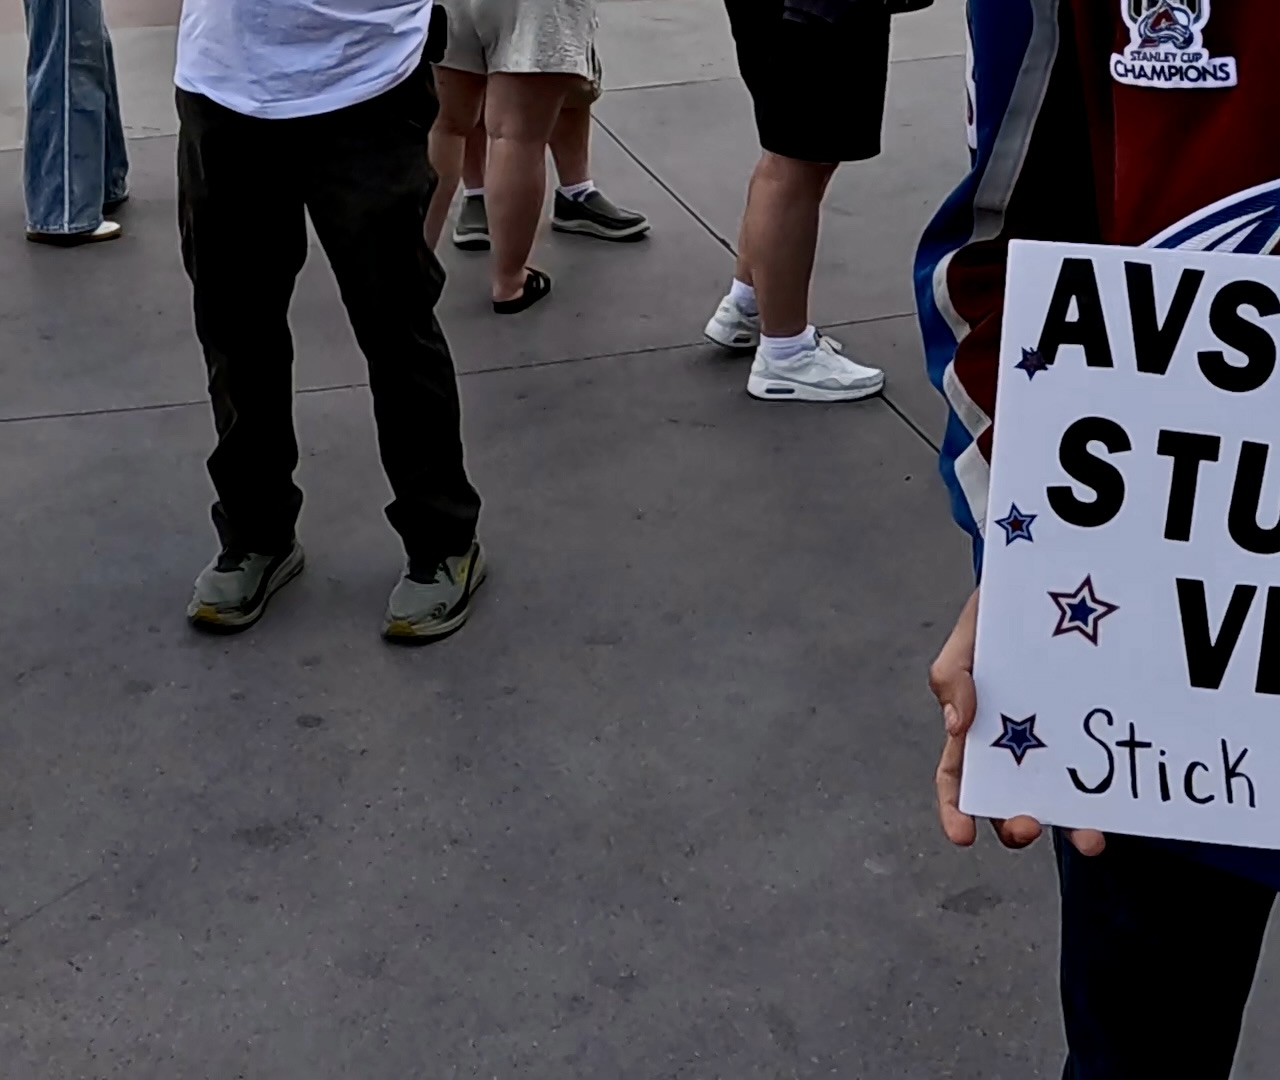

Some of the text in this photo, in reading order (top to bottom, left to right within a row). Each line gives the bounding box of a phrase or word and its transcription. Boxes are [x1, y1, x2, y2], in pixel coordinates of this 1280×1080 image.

[1130, 50, 1204, 63] STANLEY CUP
[1114, 60, 1231, 82] CHAMPIONS
[1067, 707, 1258, 809] Stick
